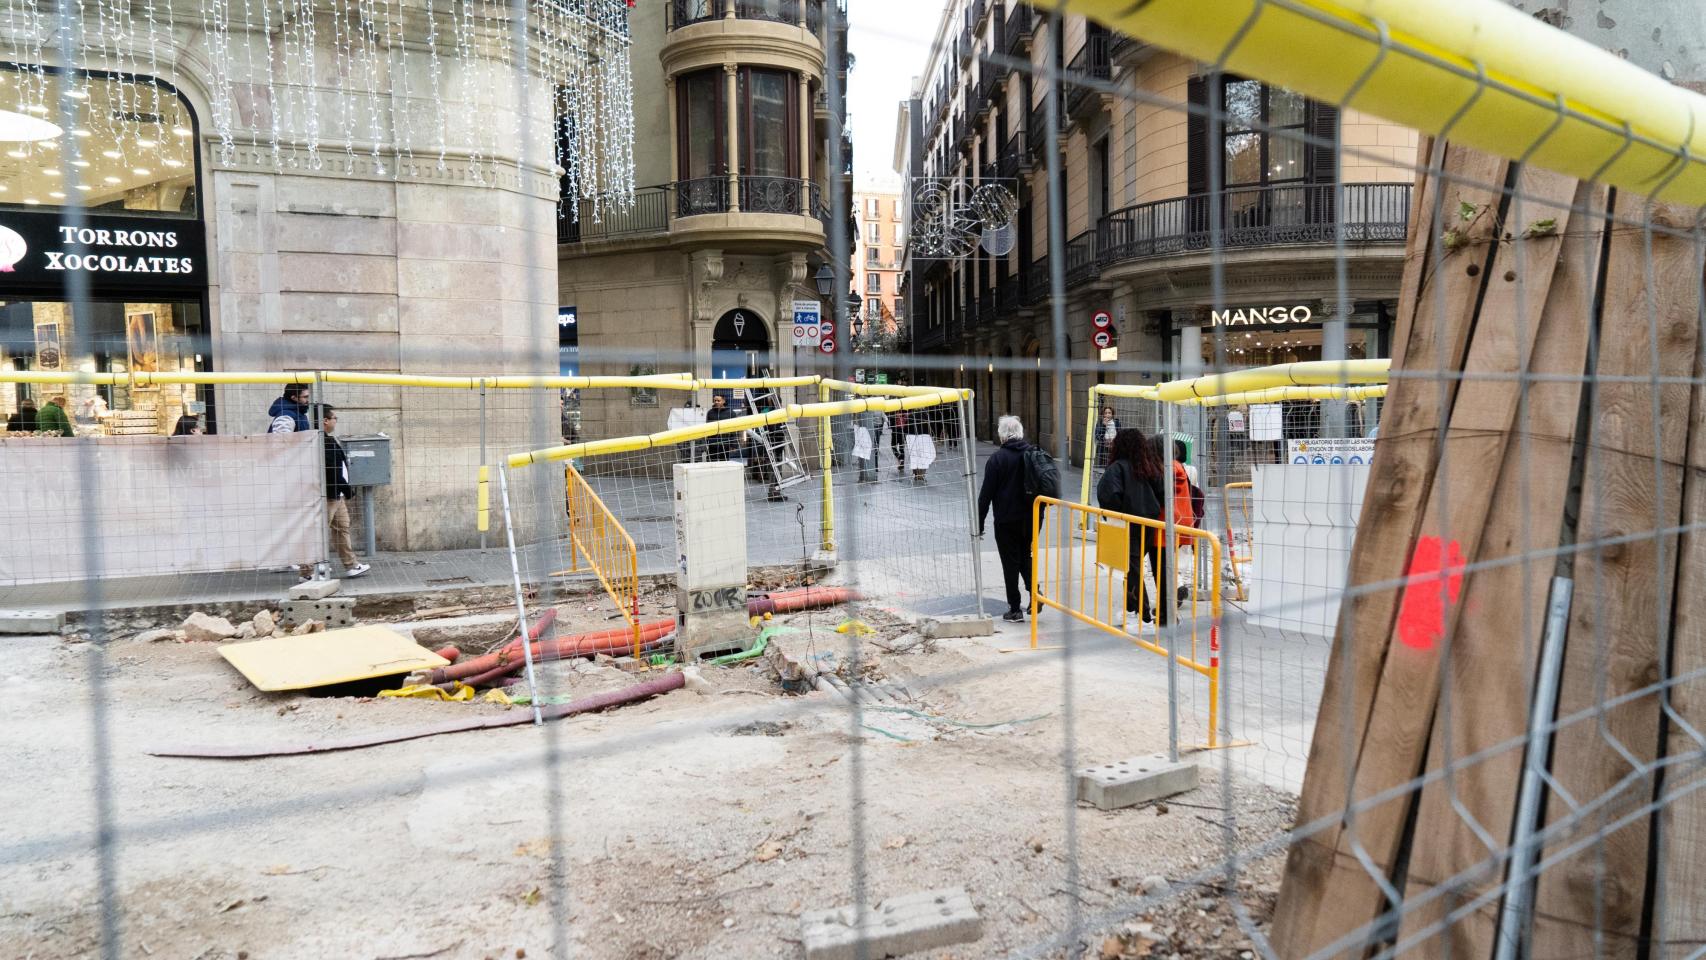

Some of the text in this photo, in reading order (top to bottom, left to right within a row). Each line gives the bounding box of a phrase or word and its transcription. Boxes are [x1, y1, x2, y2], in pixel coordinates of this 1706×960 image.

[59, 226, 178, 248] TORRONS
[44, 252, 193, 274] XOCOLATES
[1211, 305, 1311, 327] MANGO
